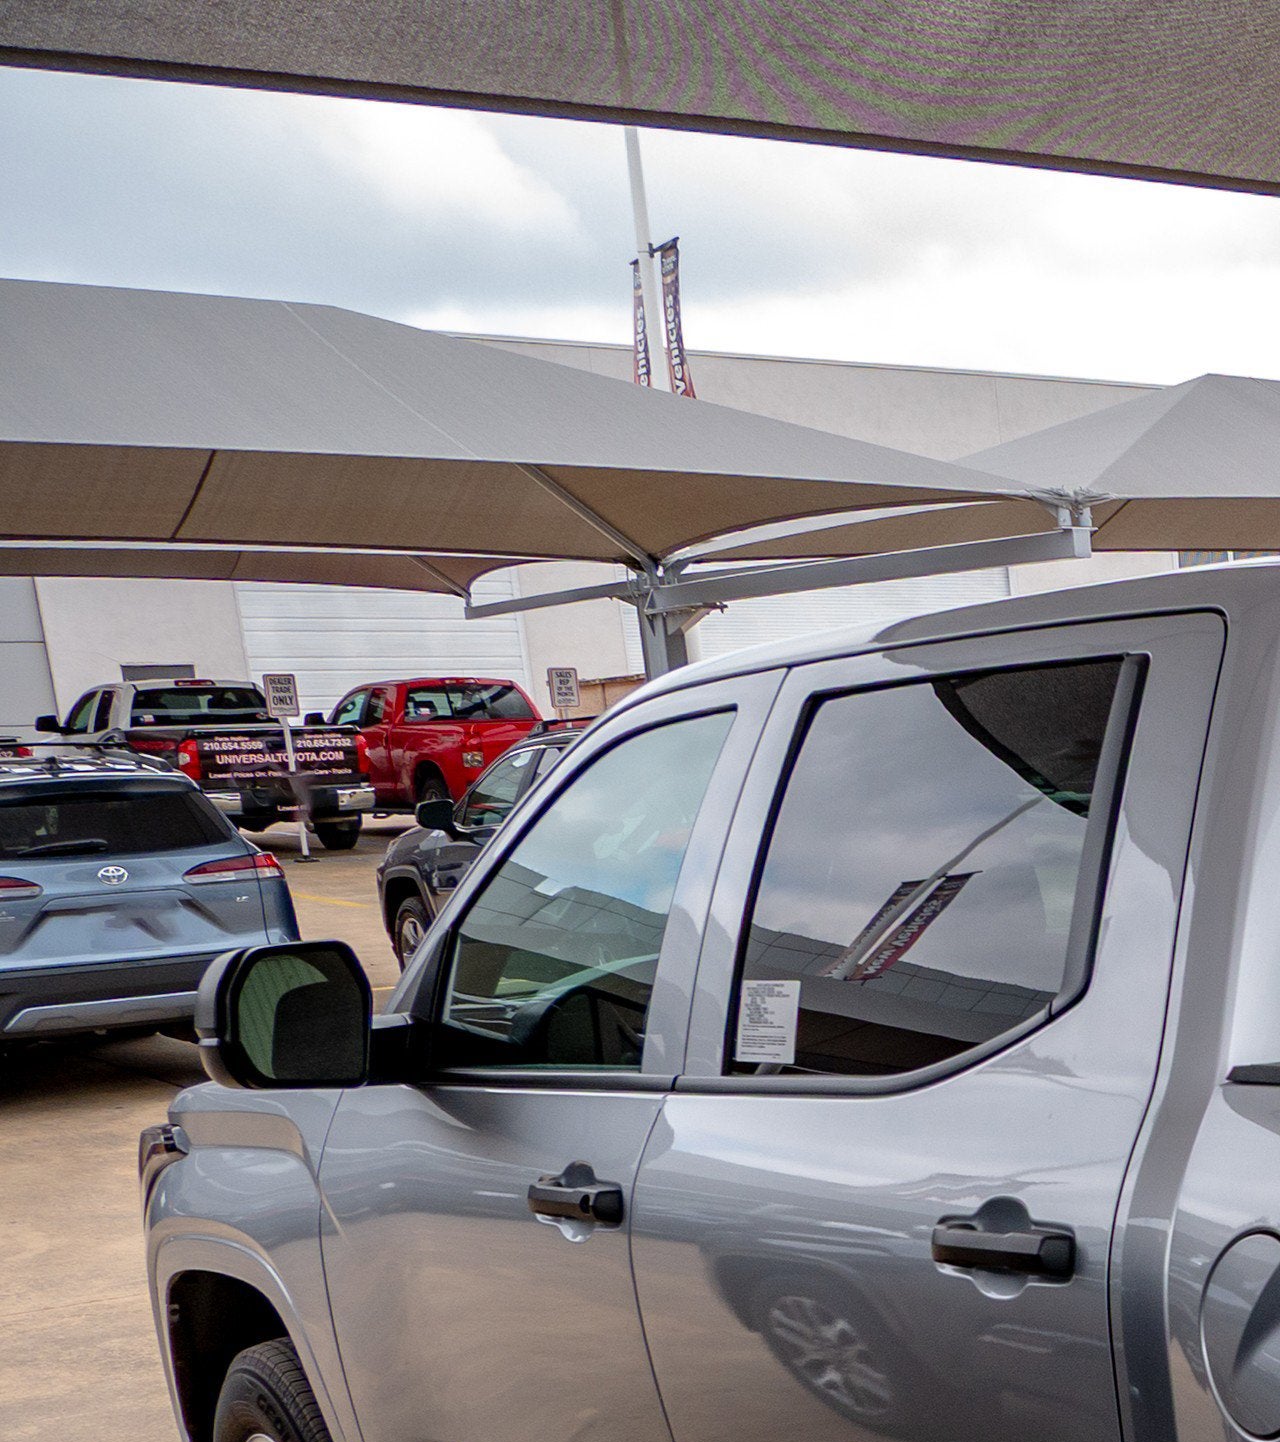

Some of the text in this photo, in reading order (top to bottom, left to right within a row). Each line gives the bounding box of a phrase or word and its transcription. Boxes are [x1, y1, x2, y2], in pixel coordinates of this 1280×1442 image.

[637, 306, 649, 387] ehicles
[269, 677, 292, 685] DEALER
[271, 685, 292, 694] TRADE
[272, 695, 294, 706] ONLY
